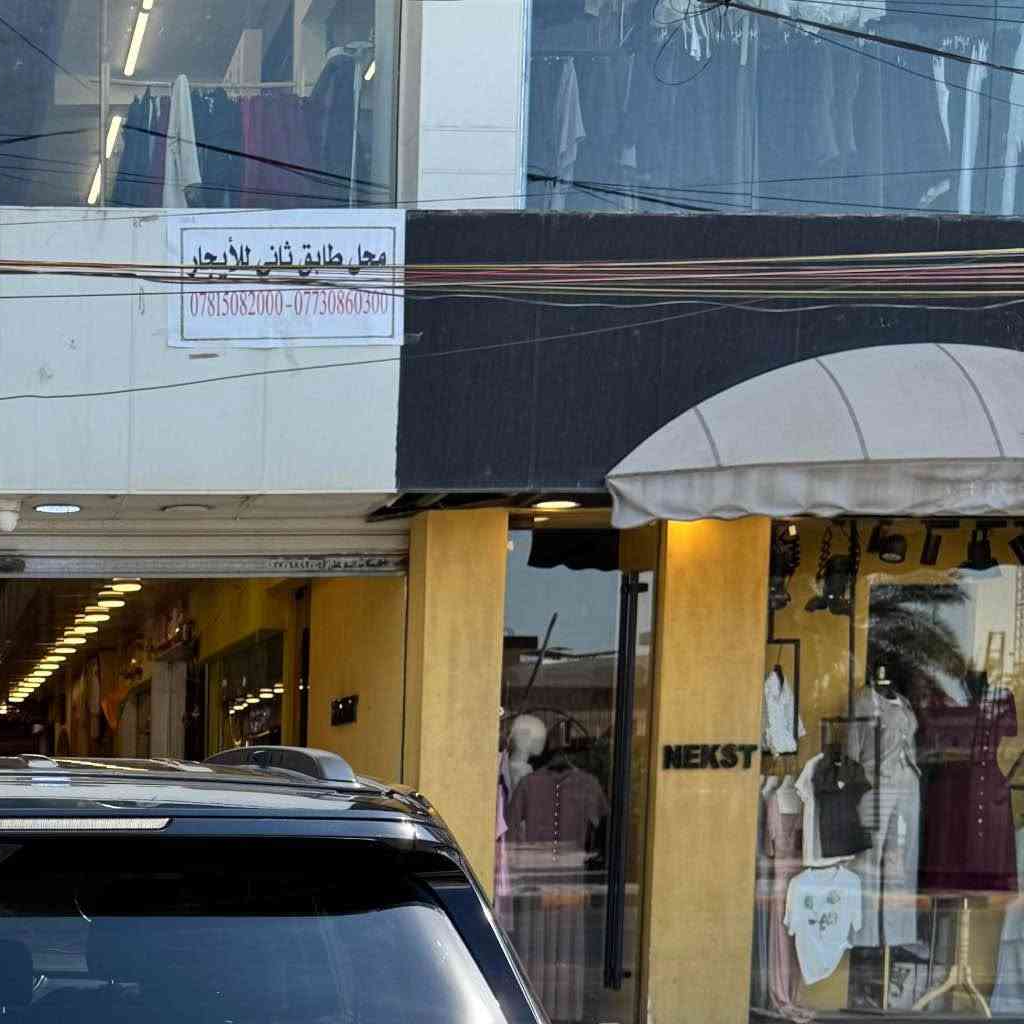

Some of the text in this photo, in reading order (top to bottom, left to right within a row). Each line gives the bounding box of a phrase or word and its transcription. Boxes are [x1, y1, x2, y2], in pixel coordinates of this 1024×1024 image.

[298, 242, 344, 276] طابق
[349, 243, 387, 275] محل
[662, 744, 758, 769] NEKST
